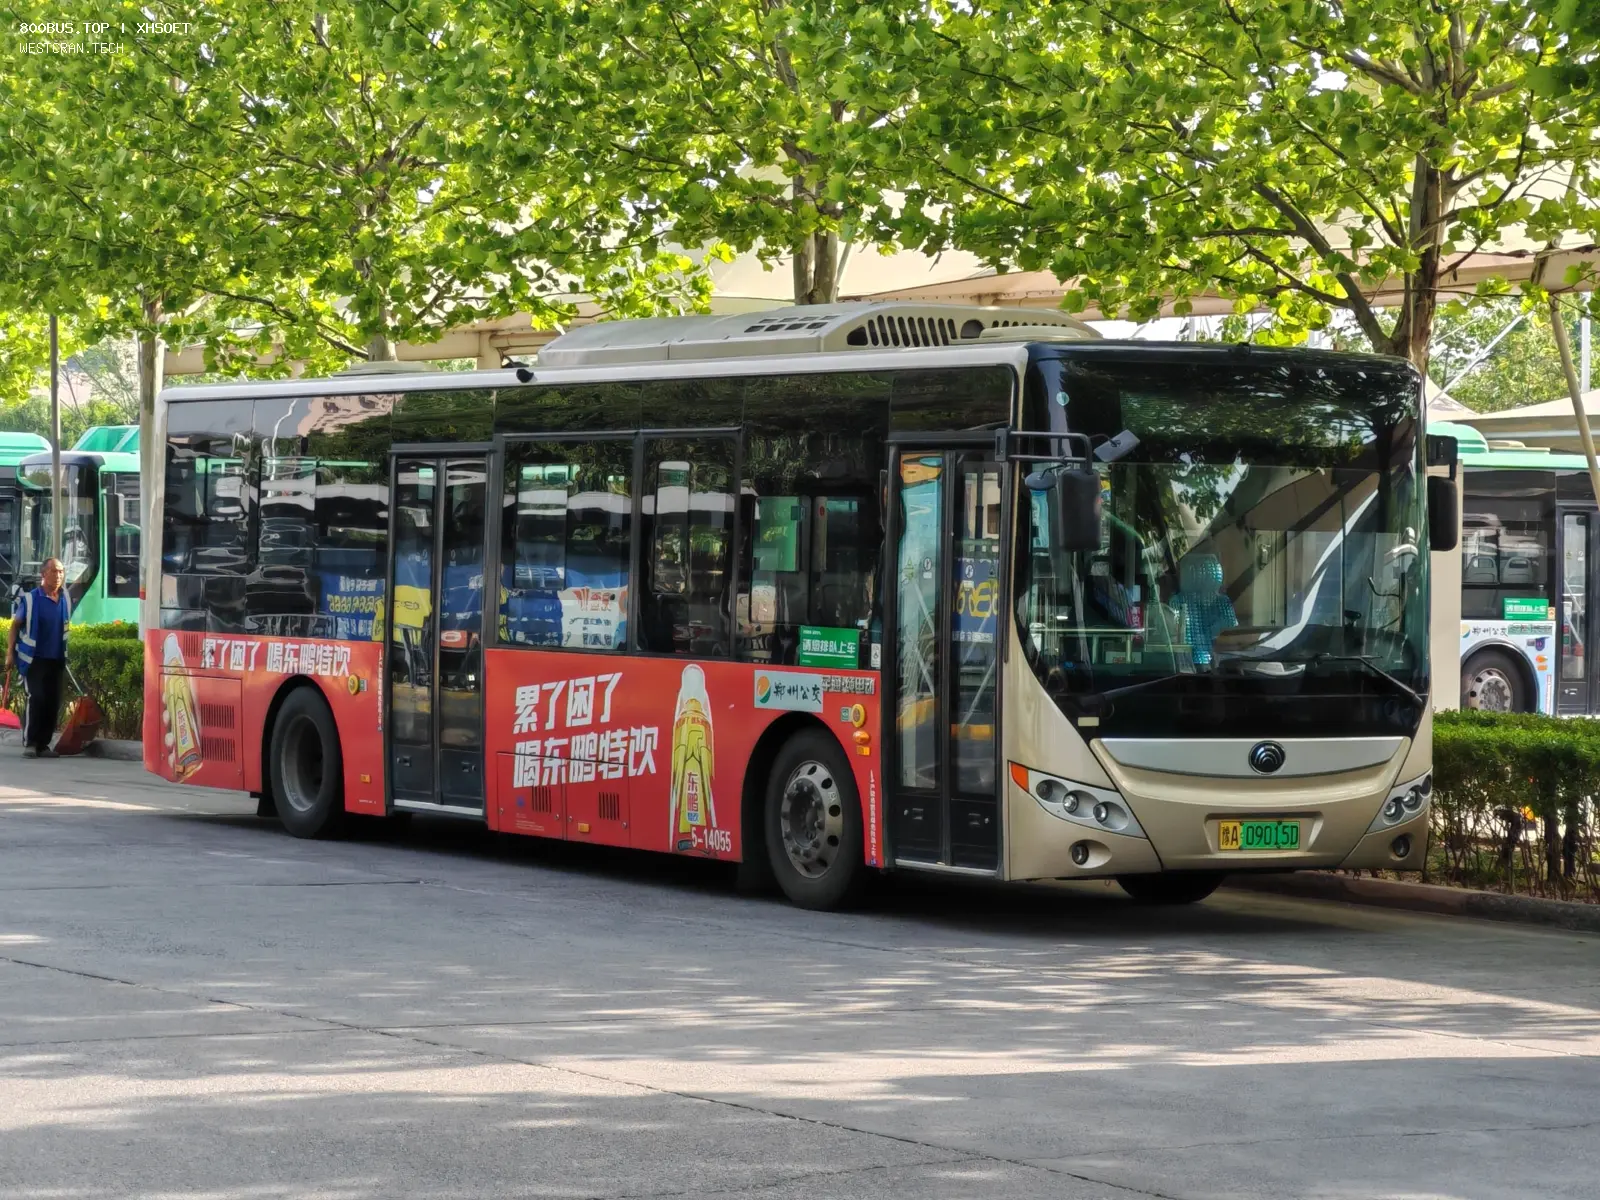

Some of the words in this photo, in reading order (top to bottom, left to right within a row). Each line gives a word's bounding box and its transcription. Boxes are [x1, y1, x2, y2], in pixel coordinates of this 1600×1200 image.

[513, 672, 623, 734] 累了困了
[773, 681, 822, 705] 郑州公交
[513, 724, 659, 788] 喝东鹏特饮
[691, 826, 732, 852] 5-14055
